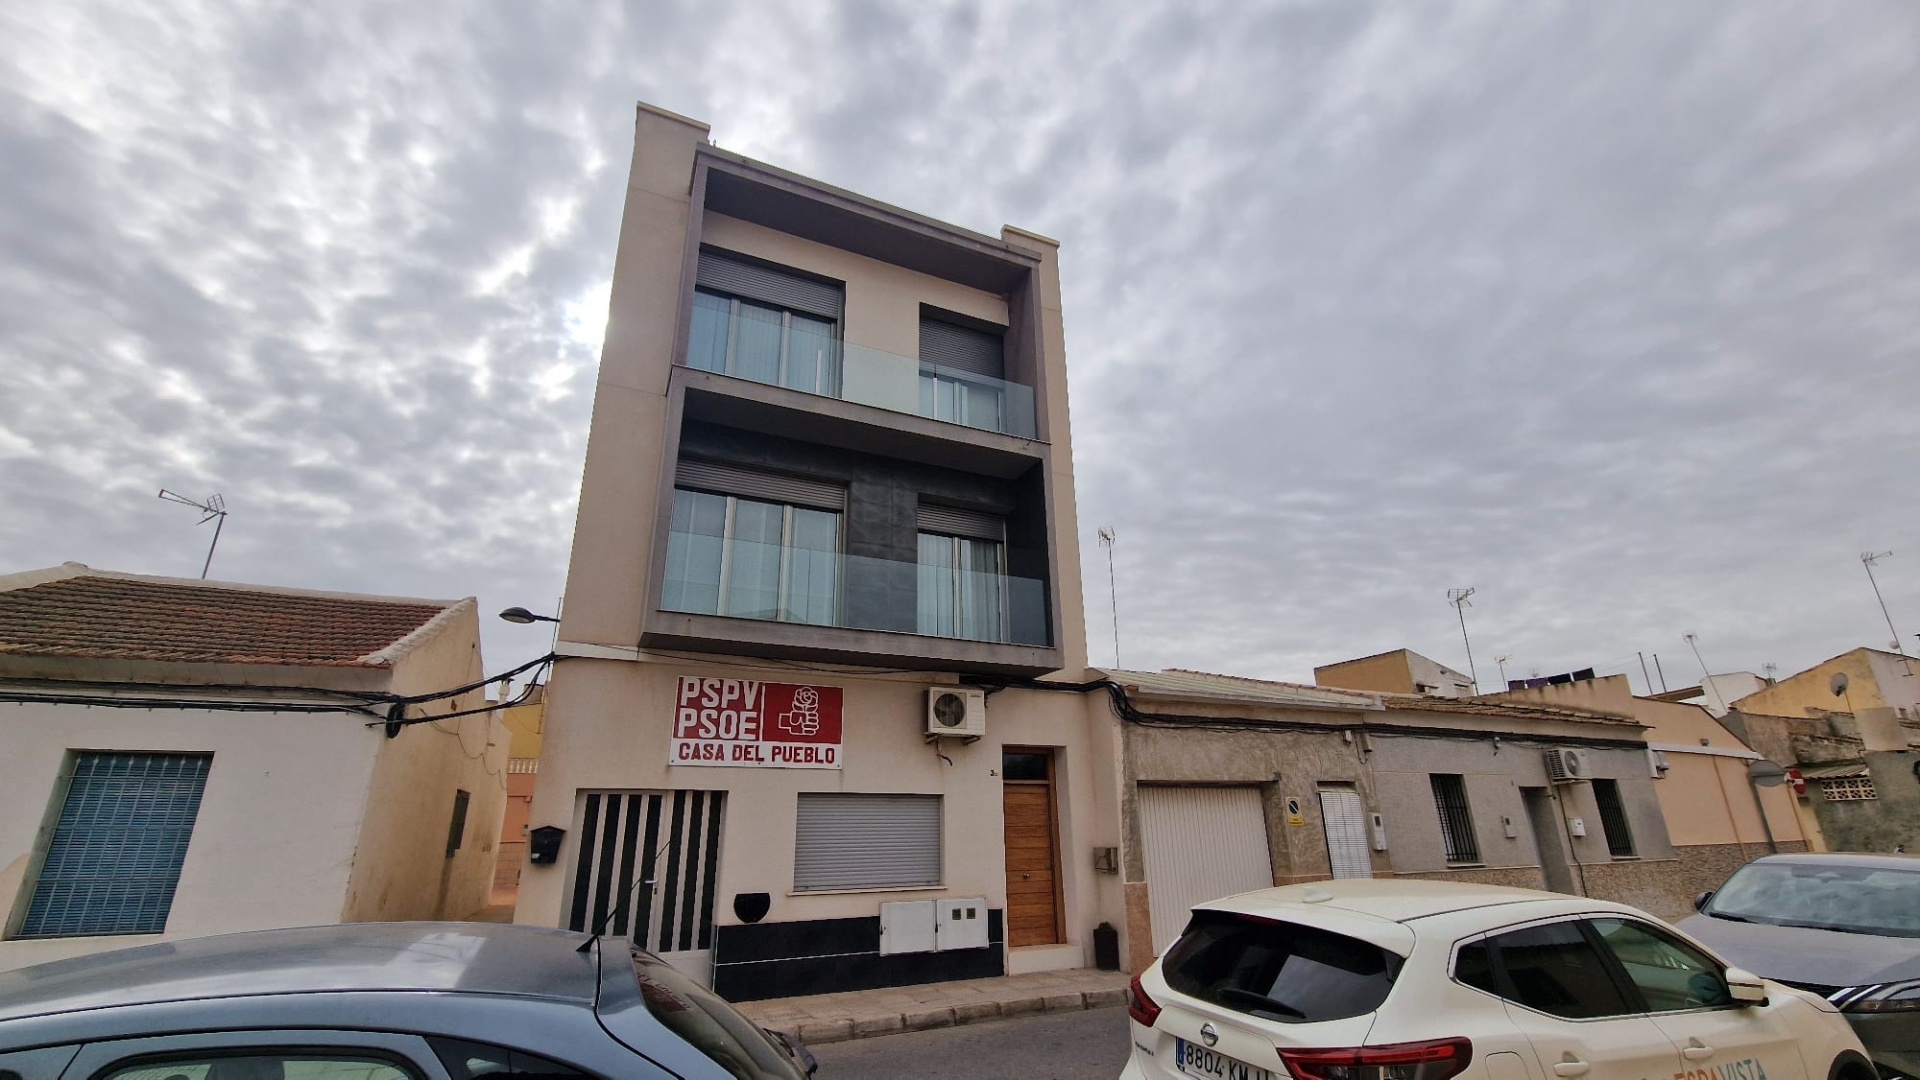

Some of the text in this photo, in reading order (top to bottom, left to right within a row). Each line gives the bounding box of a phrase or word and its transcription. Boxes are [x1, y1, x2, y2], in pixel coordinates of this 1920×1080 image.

[681, 677, 758, 709] PSPV
[677, 708, 758, 740] PSOE
[678, 743, 835, 764] CASA DEL PUEBLO
[1186, 1045, 1223, 1077] 8804
